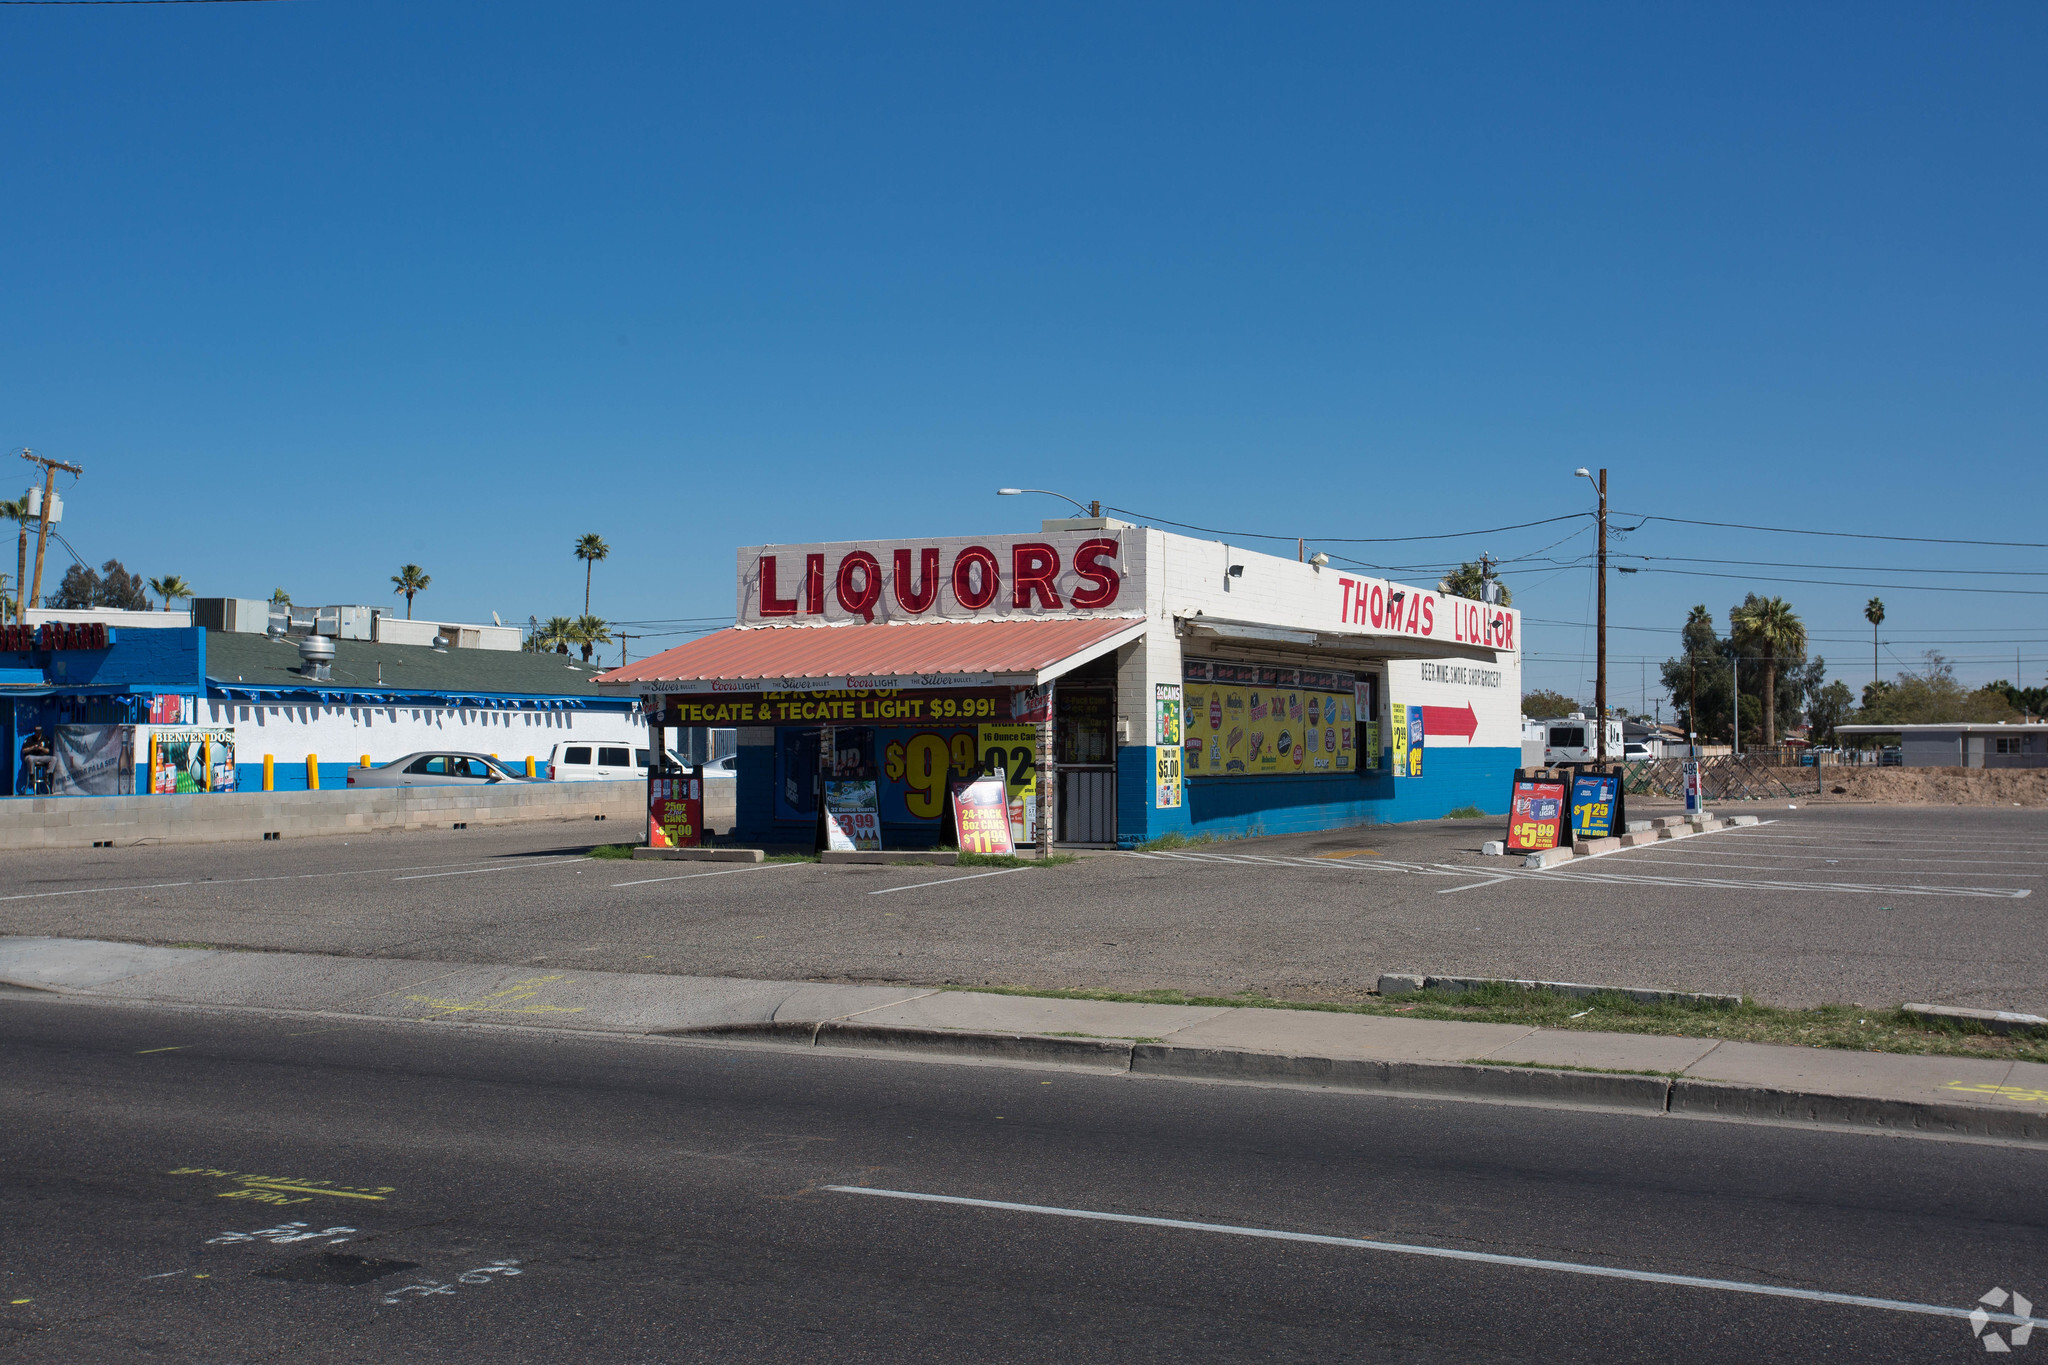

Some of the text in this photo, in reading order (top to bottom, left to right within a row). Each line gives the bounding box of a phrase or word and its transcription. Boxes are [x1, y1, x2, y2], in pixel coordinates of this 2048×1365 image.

[760, 538, 1120, 623] LIQUORS
[1339, 578, 1513, 649] THOMAS LIQUOR
[40, 623, 105, 651] BOARD
[711, 680, 737, 691] Coors
[782, 678, 811, 690] Silver
[846, 677, 873, 688] Coors
[921, 675, 953, 686] Silver
[651, 681, 679, 692] Silver
[1163, 686, 1180, 701] CANS
[677, 698, 996, 721] TECATE & TECATE LIGHT $9.99!
[155, 732, 232, 743] BIENVENDOS
[983, 733, 992, 741] 16
[993, 733, 1018, 741] Ounce
[1159, 760, 1178, 779] $5.00
[664, 802, 686, 812] 25oz
[664, 814, 688, 823] CANS
[962, 808, 1003, 820] 24-PACK
[1539, 809, 1556, 817] LIGHT
[981, 819, 1005, 830] CANS
